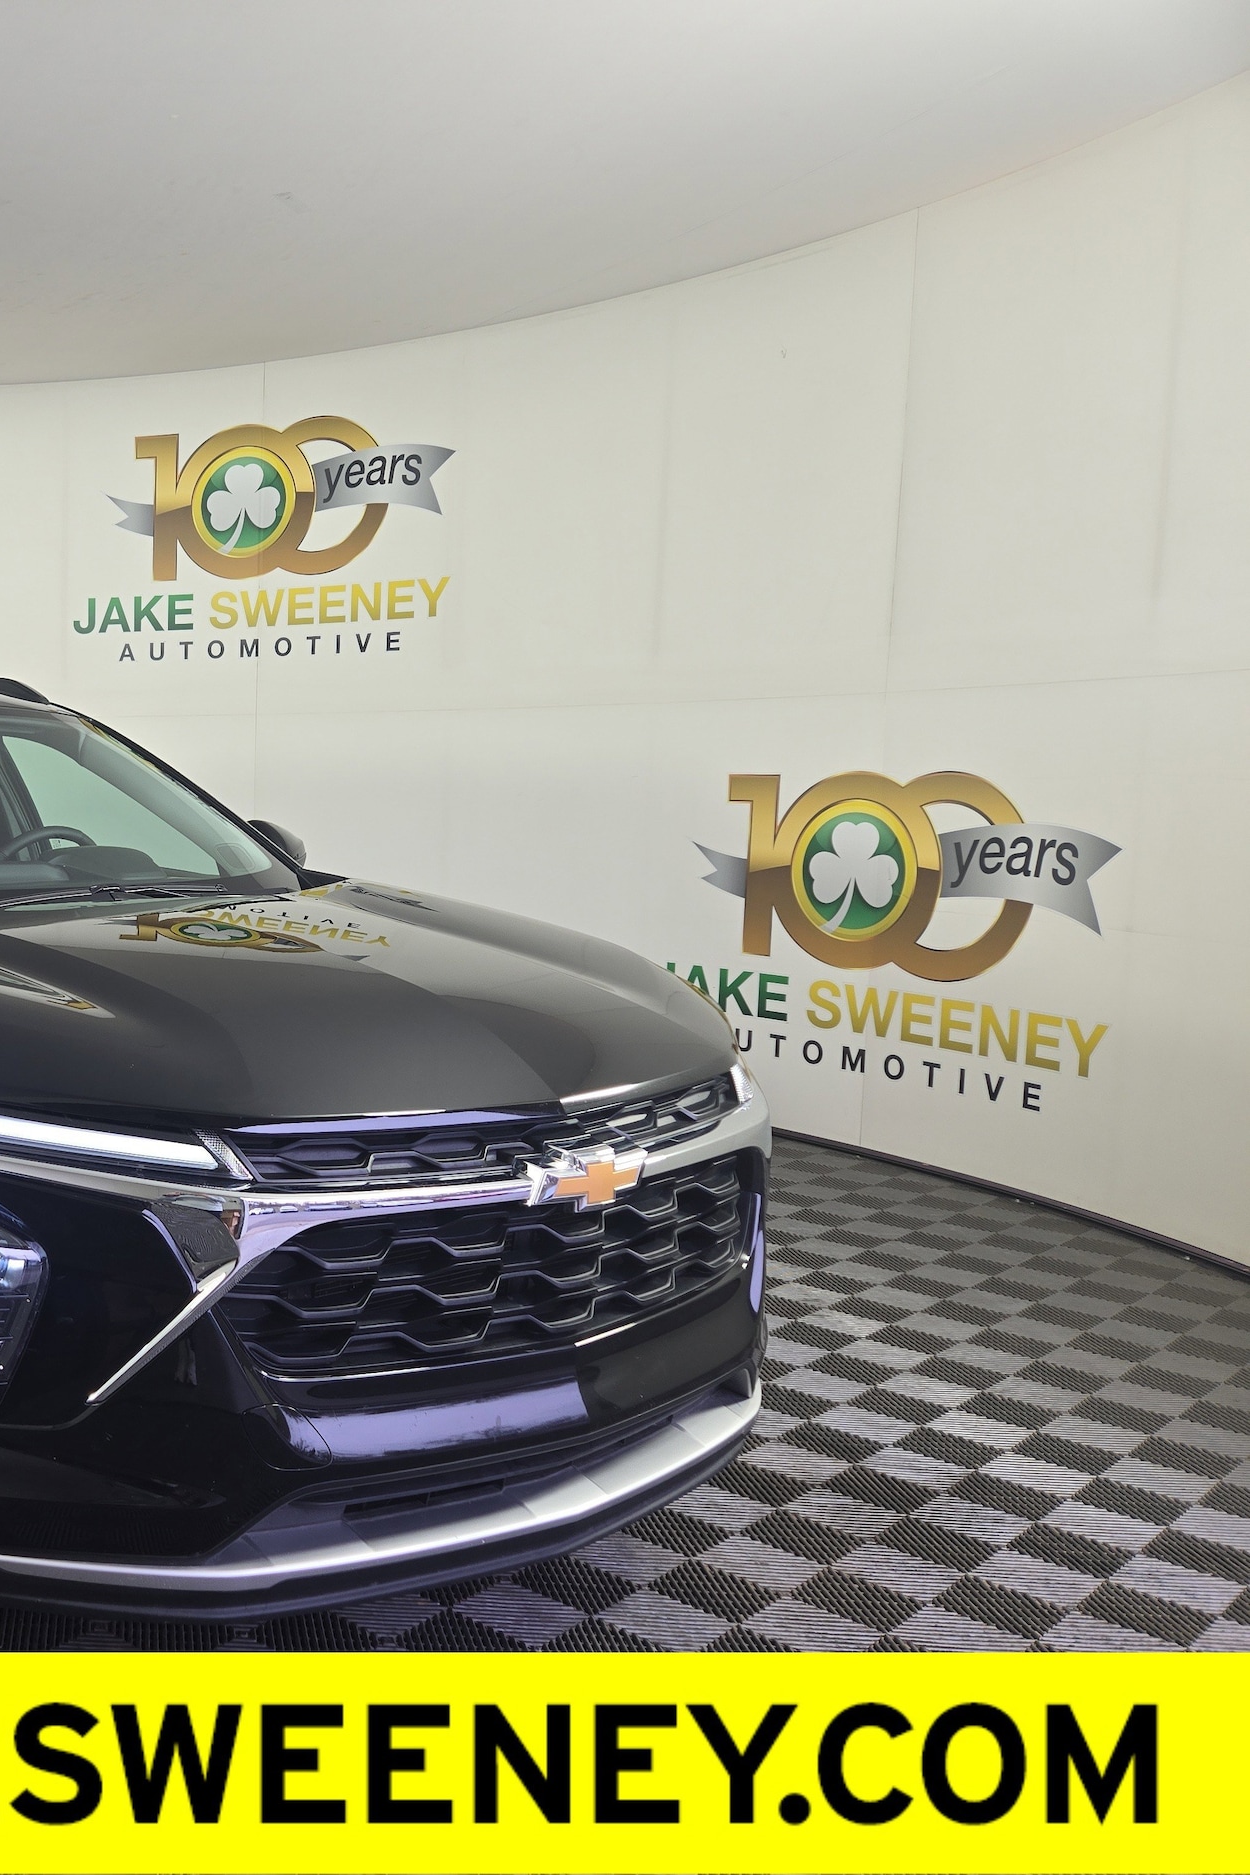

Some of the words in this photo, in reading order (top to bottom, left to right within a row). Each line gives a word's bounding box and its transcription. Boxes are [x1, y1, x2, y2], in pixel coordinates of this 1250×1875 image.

[134, 415, 389, 581] 100
[323, 452, 422, 503] years
[73, 594, 194, 634] JAKE
[210, 576, 450, 629] SWEENEY
[119, 631, 401, 661] AUTOMOTIVE
[728, 771, 1034, 982] 100
[950, 835, 1078, 887] years
[735, 1028, 1042, 1111] UTOMOTIVE
[806, 980, 1109, 1078] SWEENEY
